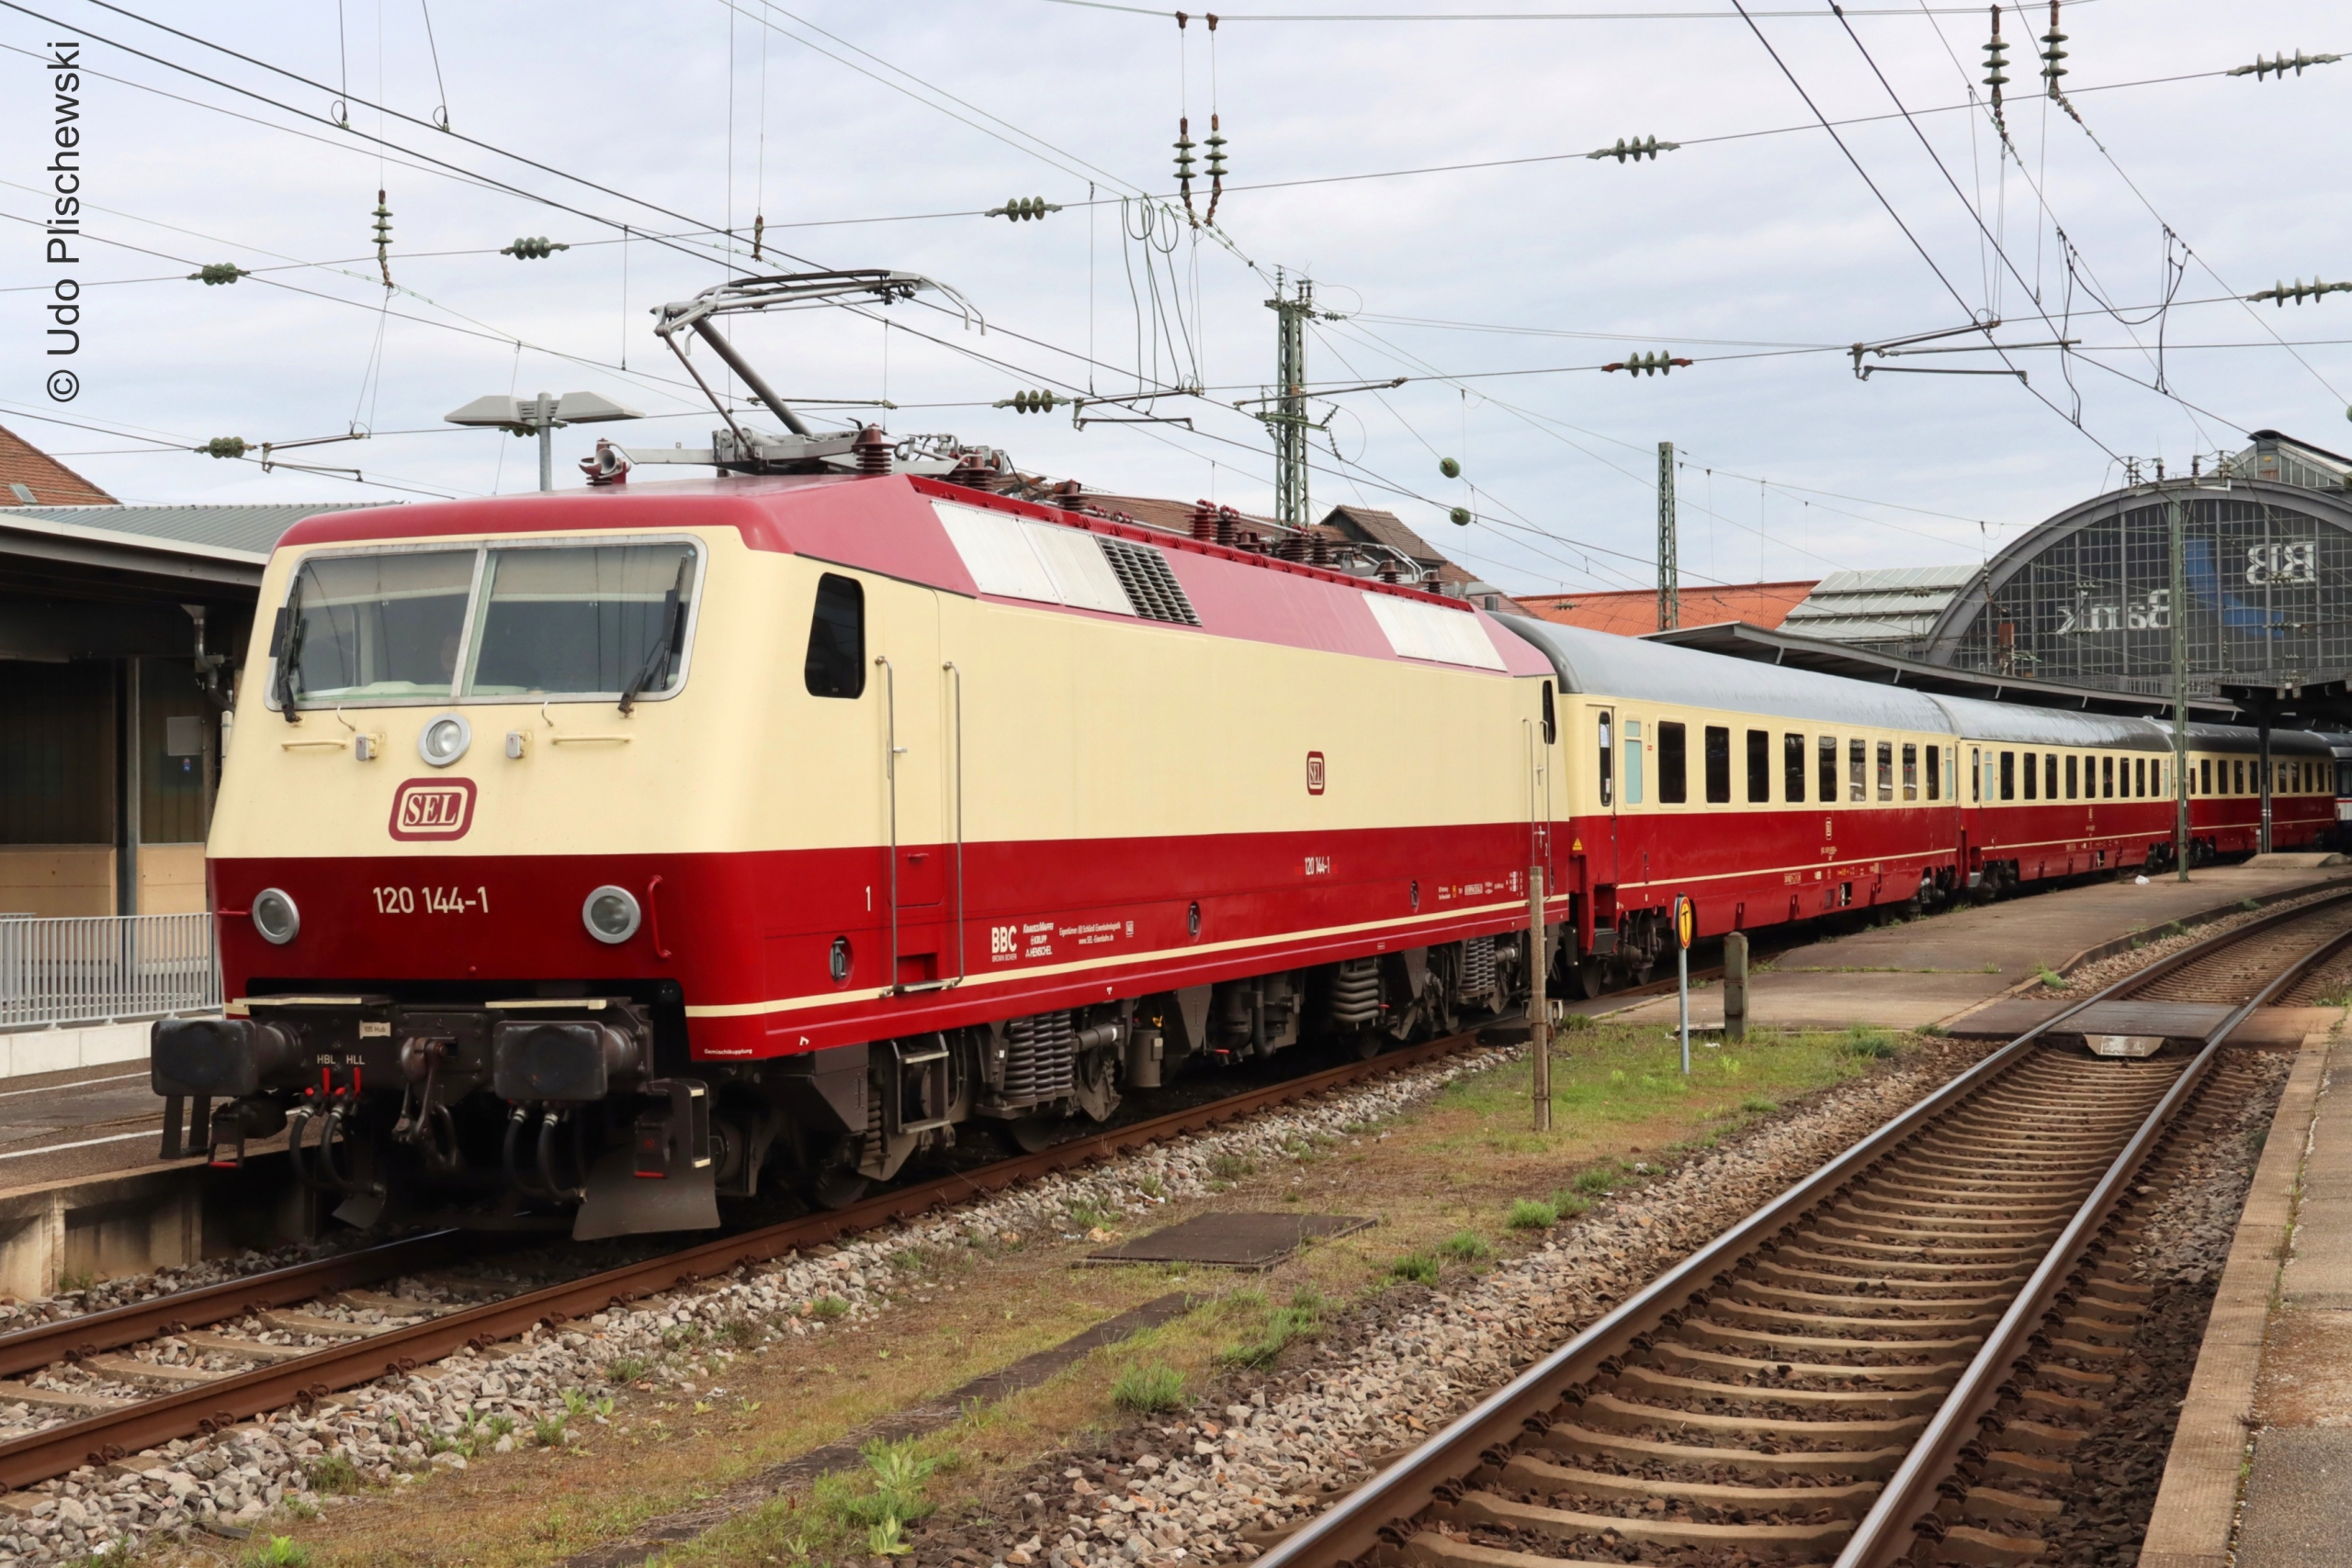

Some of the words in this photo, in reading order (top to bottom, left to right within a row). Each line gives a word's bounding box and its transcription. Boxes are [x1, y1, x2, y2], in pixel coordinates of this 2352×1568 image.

[404, 794, 457, 825] SEL
[1305, 857, 1315, 875] 120
[1316, 855, 1330, 874] 144-1
[372, 886, 414, 914] 120
[422, 886, 489, 914] 144-1
[865, 886, 871, 912] 1
[991, 925, 1017, 953] BBC
[1031, 945, 1053, 957] HENSCHEL
[317, 1055, 336, 1065] HBL
[346, 1055, 365, 1066] HLL
